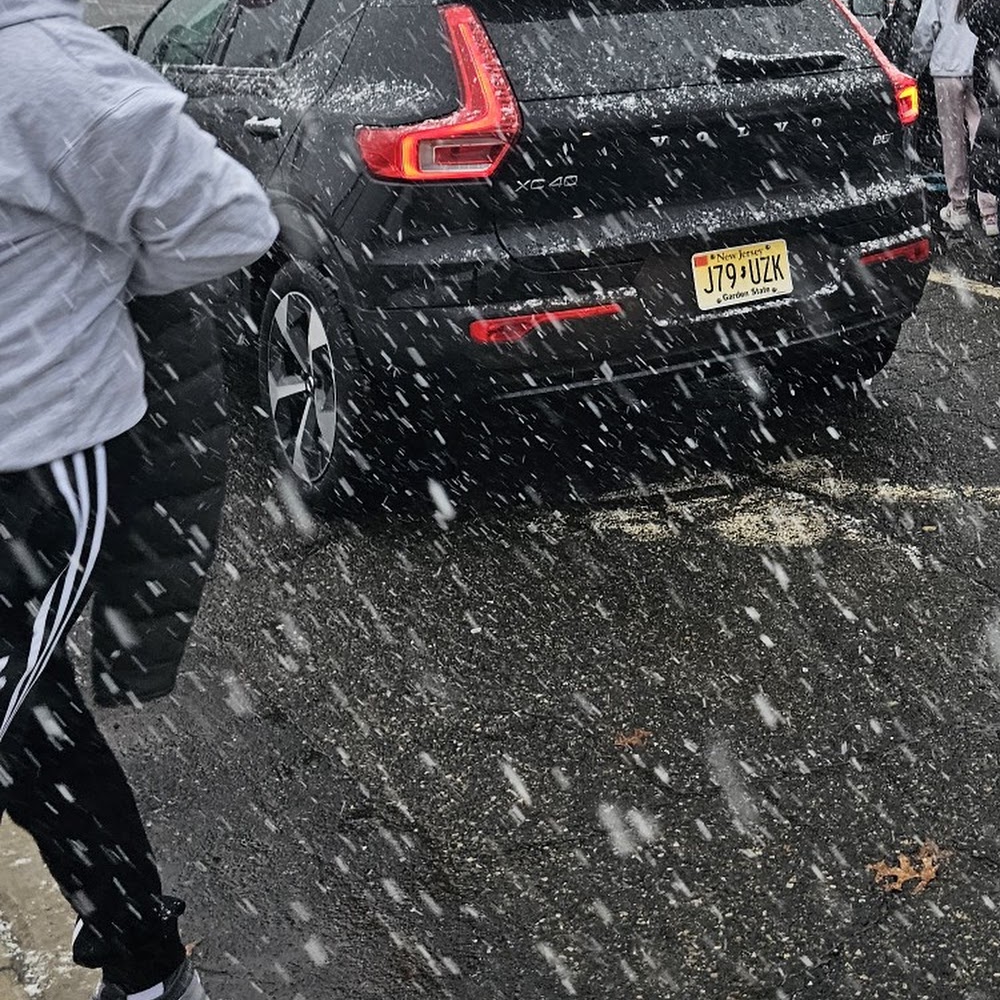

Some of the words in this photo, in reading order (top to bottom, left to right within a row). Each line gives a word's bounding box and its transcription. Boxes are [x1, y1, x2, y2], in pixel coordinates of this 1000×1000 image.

[650, 117, 822, 147] VOLVO
[515, 174, 578, 193] XC40
[717, 251, 736, 262] New
[738, 247, 764, 260] Jersey
[722, 290, 749, 302] Garden
[751, 286, 770, 296] State
